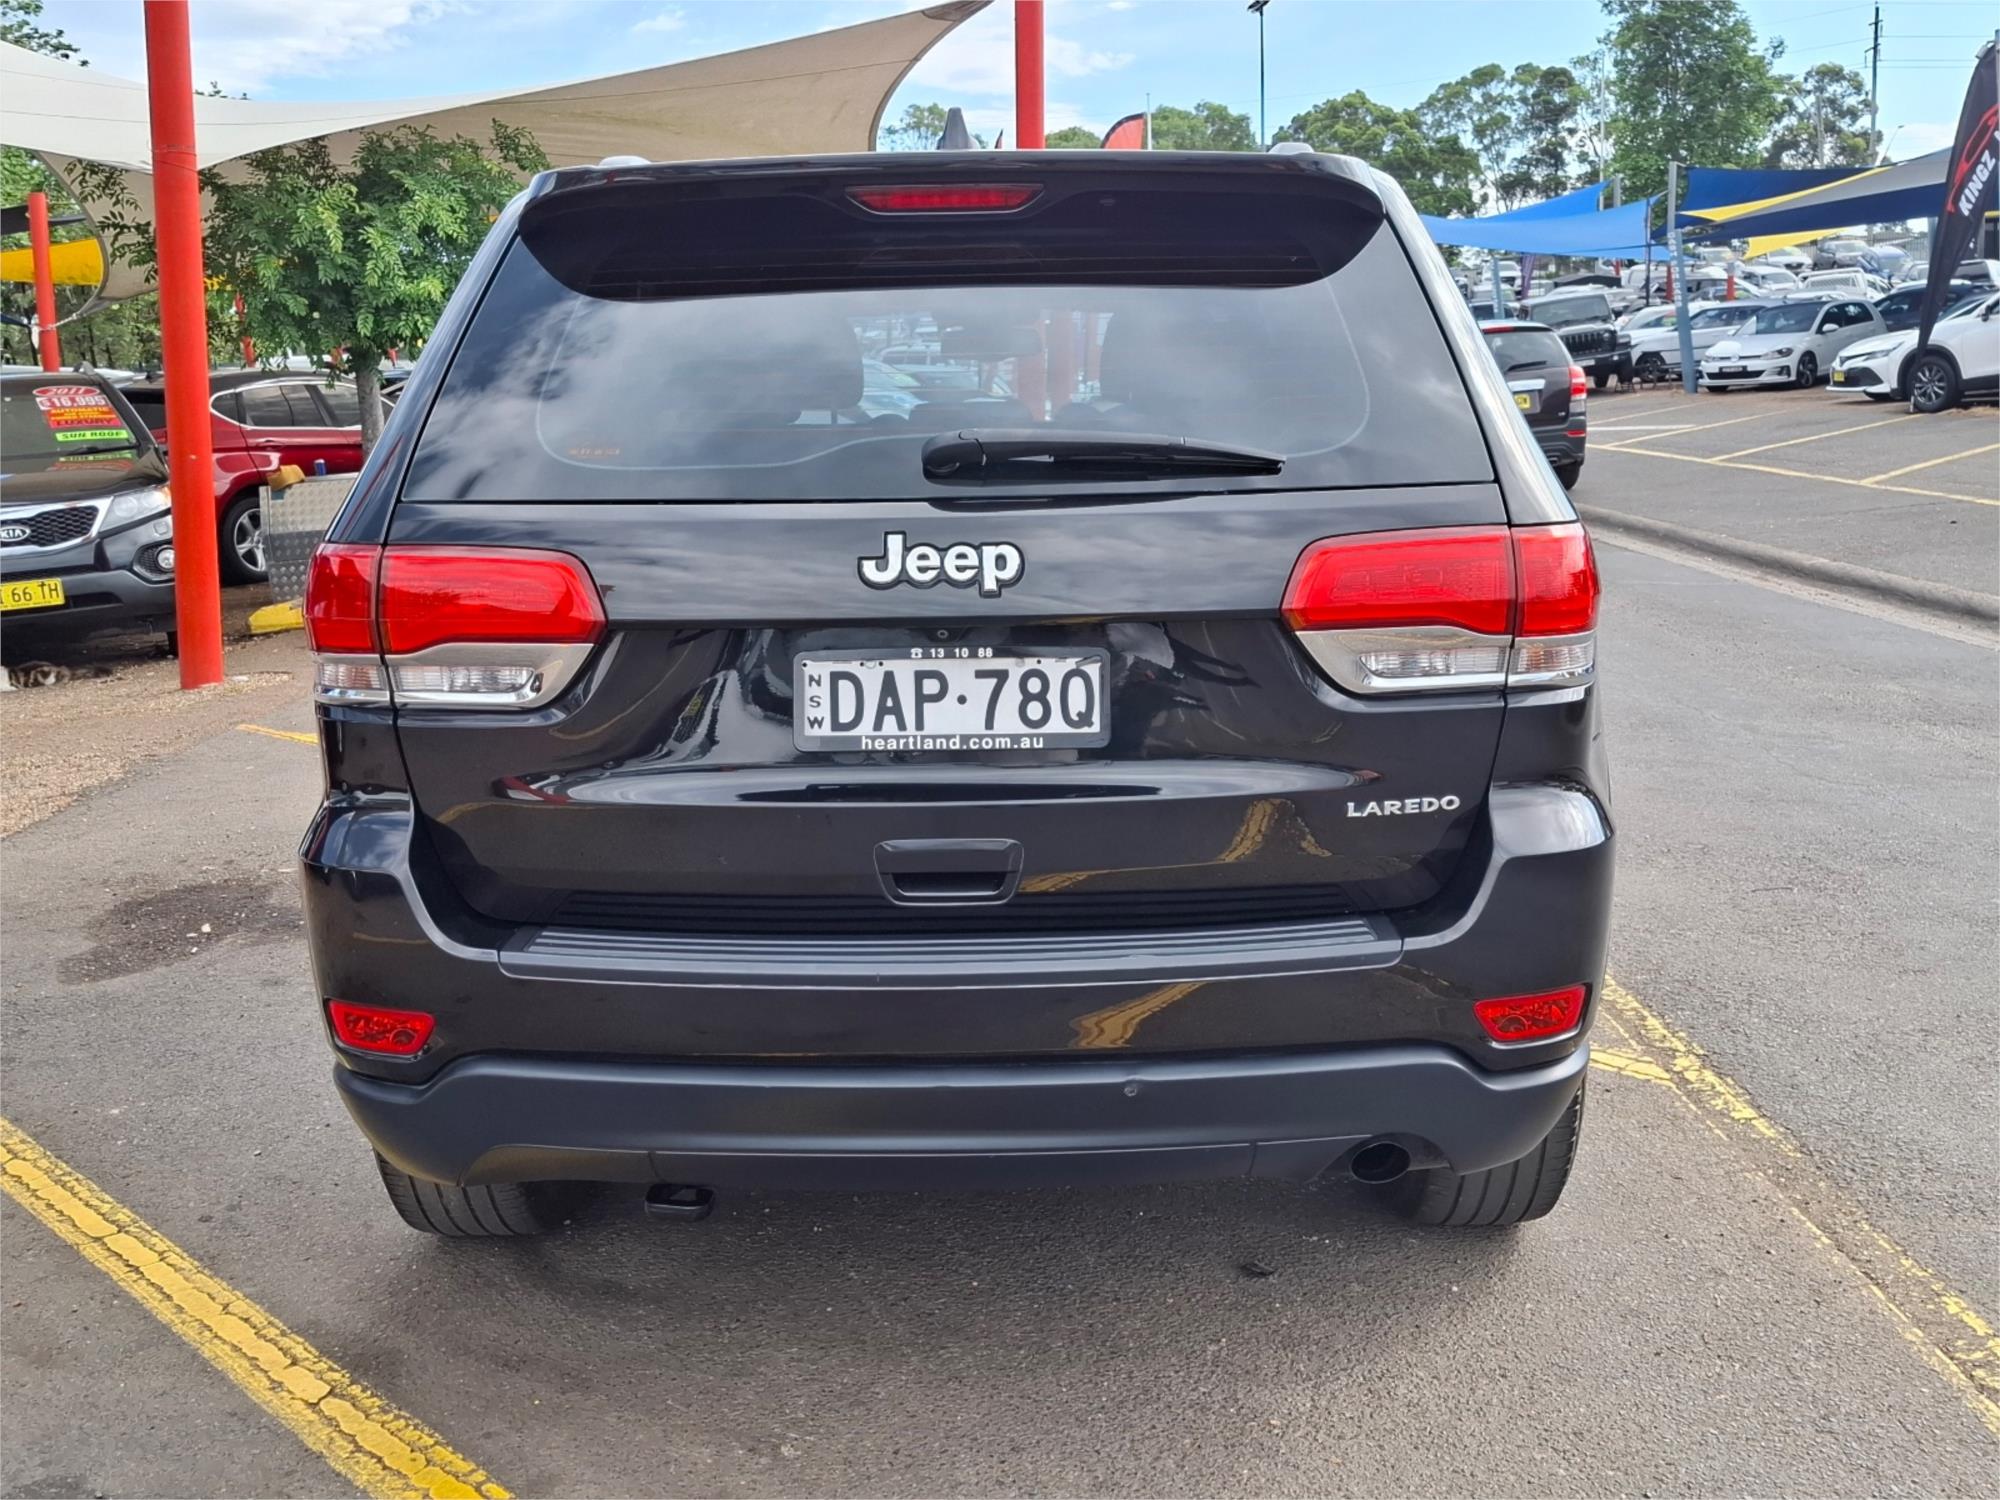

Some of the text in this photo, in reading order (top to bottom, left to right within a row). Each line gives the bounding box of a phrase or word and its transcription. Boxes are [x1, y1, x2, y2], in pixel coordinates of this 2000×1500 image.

[1958, 149, 1996, 217] KINGZ
[860, 532, 1023, 595] Jeep
[929, 647, 993, 658] 13 10 88
[861, 735, 1044, 750] heartland.com.au
[1346, 795, 1461, 817] LAREDO
